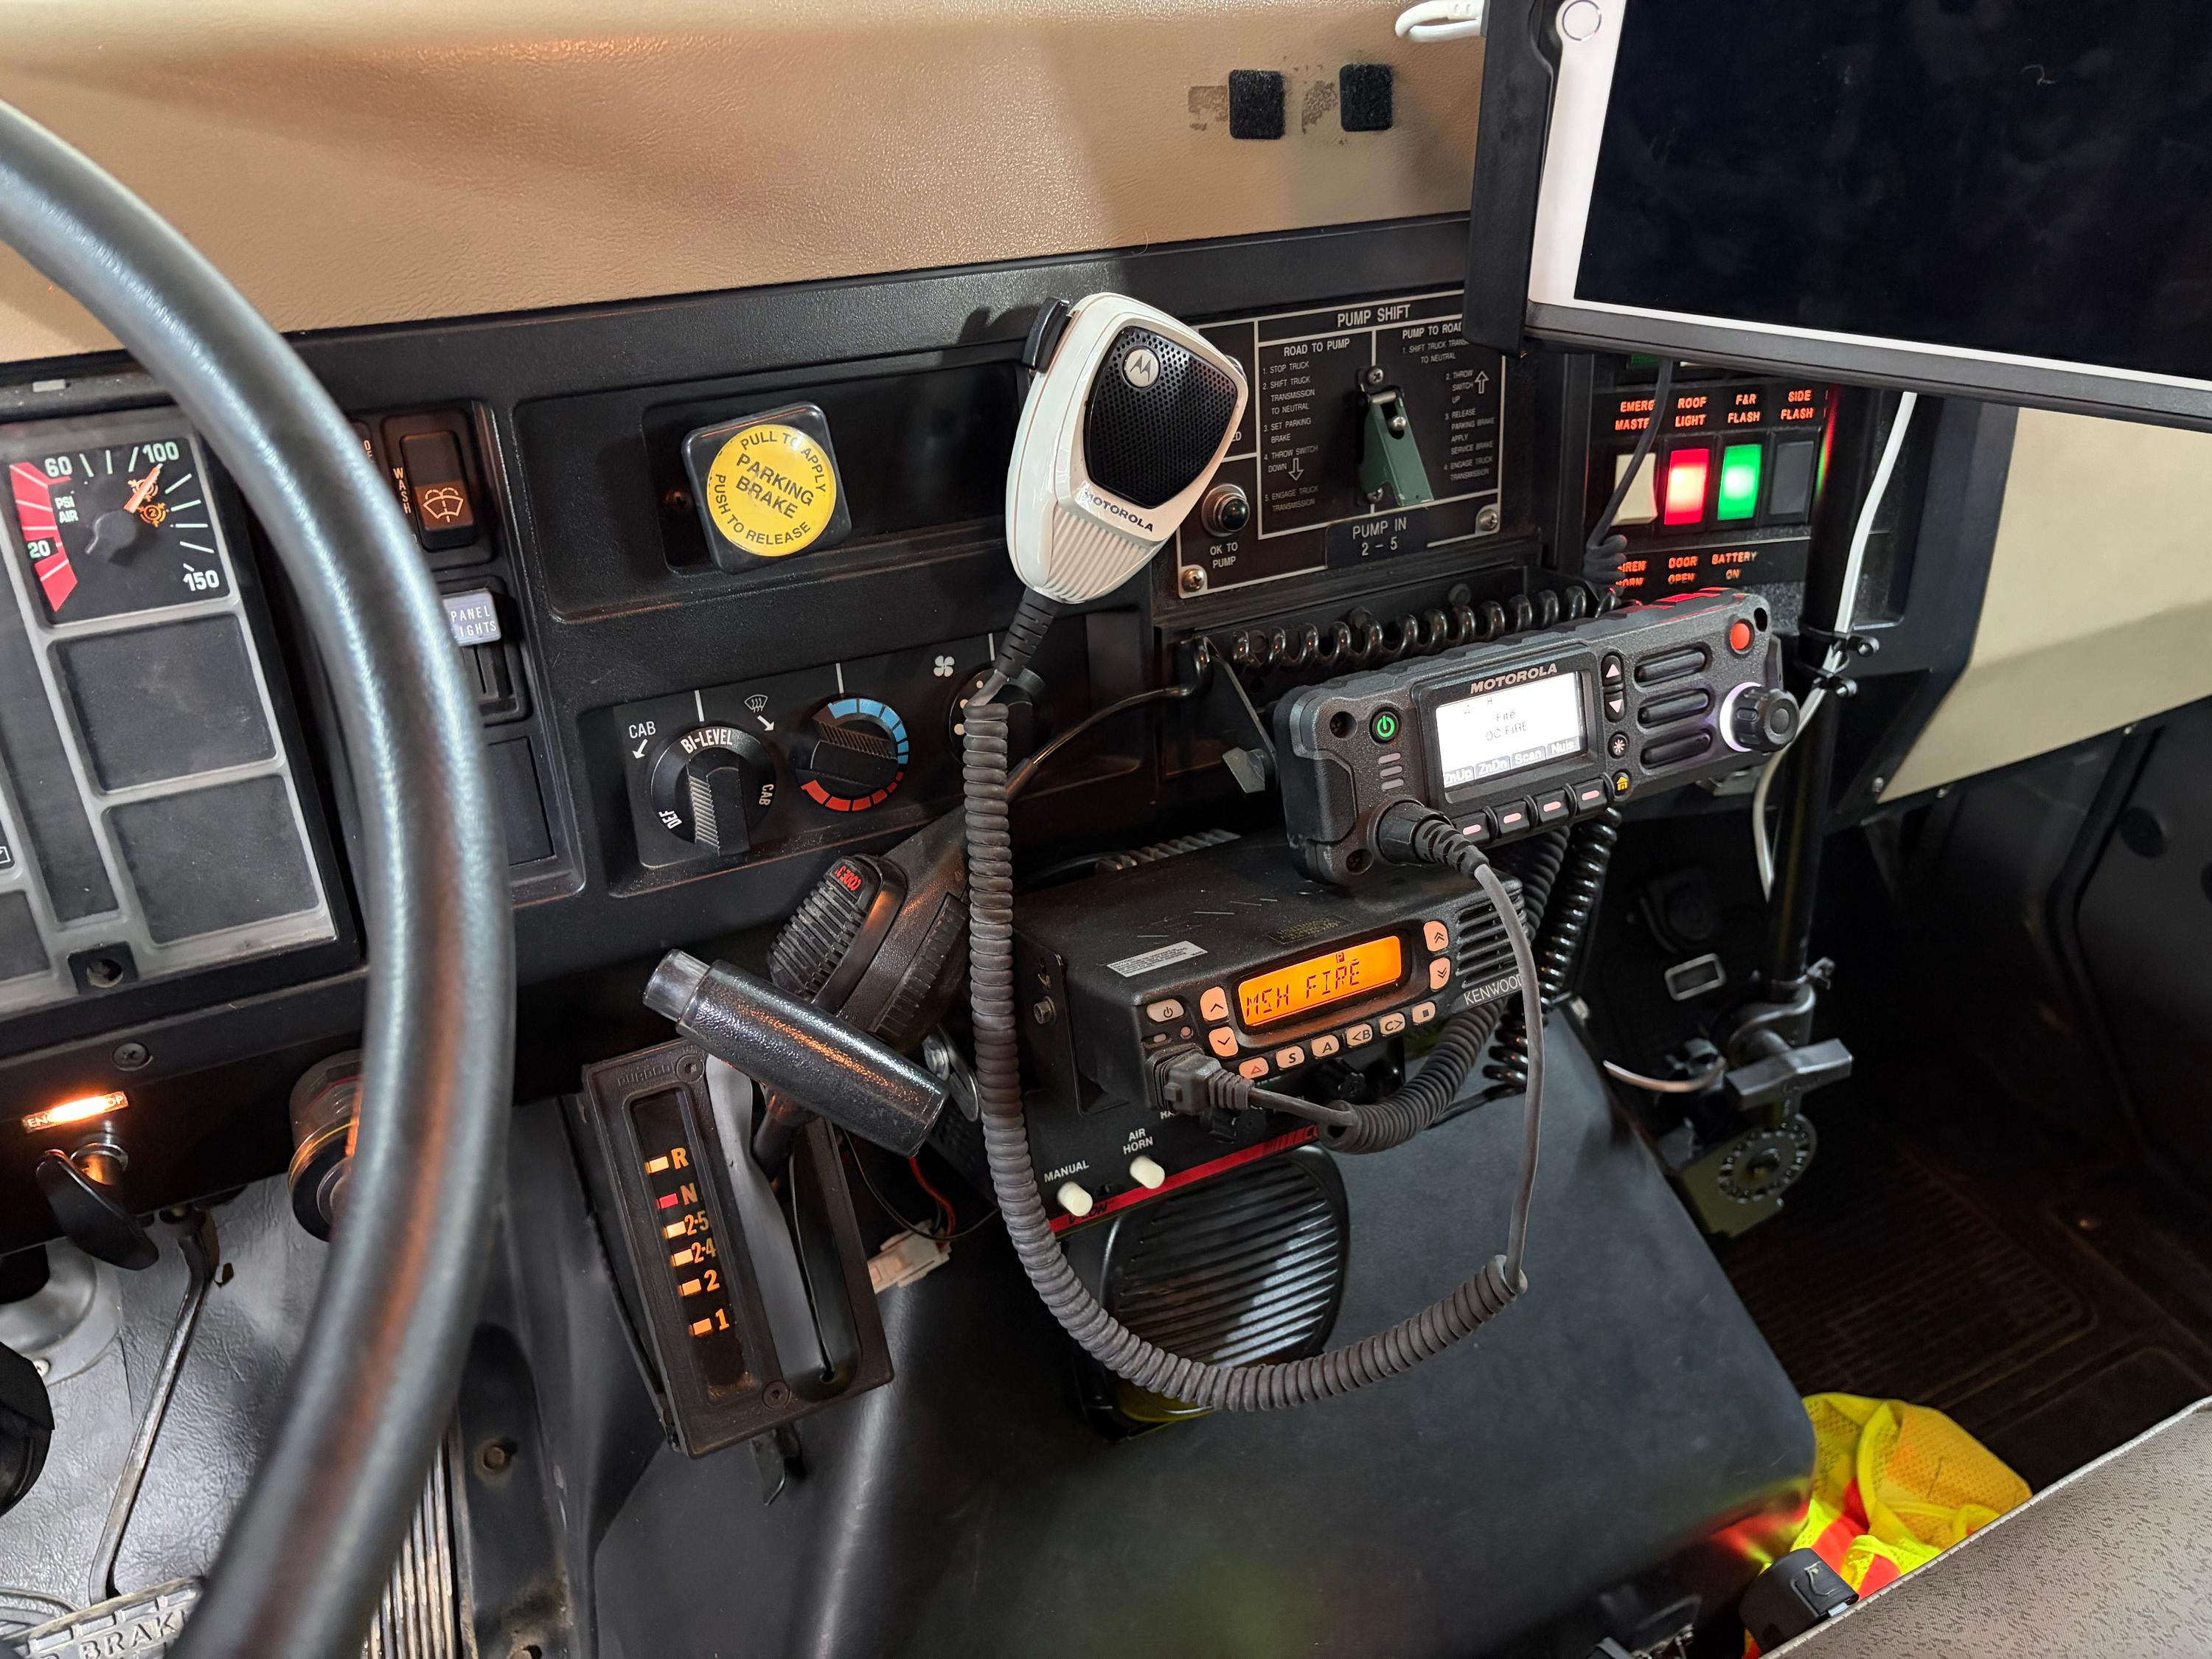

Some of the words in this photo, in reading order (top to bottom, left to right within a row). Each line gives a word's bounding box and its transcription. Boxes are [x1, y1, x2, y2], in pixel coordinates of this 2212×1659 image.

[1337, 310, 1371, 327] PUMP
[1377, 305, 1411, 323] SHIFT
[1402, 327, 1425, 340] PUMP
[1427, 325, 1439, 336] TO
[1284, 344, 1308, 357] ROAD
[1312, 342, 1324, 352] TO
[1326, 338, 1350, 351] PUMP
[1408, 343, 1425, 353] SHIFT
[1427, 341, 1447, 350] TRUCK
[1431, 352, 1456, 362] NEUTRAL
[1270, 364, 1287, 374] STOP
[1289, 361, 1310, 370] TRUCK
[1453, 369, 1474, 379] THROW
[1270, 379, 1287, 389] SHIFT
[1290, 376, 1310, 386] TRUCK
[1452, 382, 1474, 392] SWITCH
[1270, 389, 1315, 402] TRANSMISSION
[1452, 396, 1461, 404] UP
[1677, 396, 1708, 409] ROOF
[1736, 394, 1757, 406] F&R
[1788, 389, 1812, 403] SIDE
[1271, 407, 1280, 415] TO
[1282, 403, 1310, 414] NEUTRAL
[1451, 408, 1475, 419] RELEASE
[1620, 400, 1655, 413] EMERG
[1781, 407, 1814, 420] FLASH
[1270, 422, 1282, 431] SET
[1285, 417, 1312, 428] PARKING
[1615, 417, 1651, 431] MASTE
[1674, 414, 1707, 428] LIGHT
[1728, 411, 1761, 424] FLASH
[1270, 434, 1291, 444] BRAKE
[1451, 434, 1469, 443] APPLY
[142, 442, 179, 463] 100
[1271, 449, 1294, 460] THROW
[1295, 445, 1319, 455] SWITCH
[44, 456, 72, 477] 60
[740, 431, 777, 451] PULL
[782, 432, 804, 451] TO
[801, 448, 826, 493] APPLY
[1268, 462, 1287, 473] DOWN
[736, 453, 814, 507] PARKING
[393, 467, 411, 513] WASH
[1271, 489, 1296, 501] ENGAGE
[1298, 485, 1319, 494] TRUCK
[55, 495, 75, 509] PSI
[736, 476, 798, 519] BRAKE
[714, 473, 731, 515] PUSH
[727, 514, 745, 533] TO
[745, 521, 811, 546] RELEASE
[1084, 490, 1153, 532] MOTOROLA
[1272, 498, 1315, 512] TRANSMISSION
[59, 510, 79, 524] AIR
[1352, 521, 1388, 540] PUMP
[1394, 517, 1407, 532] IN
[27, 540, 51, 559] 20
[1209, 544, 1222, 556] OK
[1226, 542, 1238, 553] TO
[1361, 542, 1369, 557] 2
[1390, 537, 1398, 551] 5
[1212, 557, 1237, 569] PUMP
[1668, 556, 1699, 569] DOOR
[1711, 552, 1758, 566] BATTERY
[183, 570, 220, 591] 150
[1668, 573, 1696, 585] OPEN
[1725, 568, 1742, 580] ON
[451, 605, 490, 622] PANEL
[453, 621, 497, 639] IGHTS
[1470, 663, 1558, 695] MOTOROLA
[629, 721, 656, 739] CAB
[1486, 728, 1501, 741] OC
[1505, 722, 1528, 736] FIRE
[681, 728, 733, 754] BI-LEVEL
[1444, 769, 1474, 785] ZnUp
[1478, 759, 1508, 776] ZnDn
[1514, 749, 1542, 765] Scan
[1551, 740, 1575, 755] Nuis
[759, 783, 774, 806] CAB
[658, 810, 683, 830] DEF
[1246, 984, 1289, 1018] MSH
[1306, 960, 1360, 999] FIRE
[1322, 1042, 1332, 1054] A
[1289, 1052, 1295, 1063] S
[1128, 1128, 1146, 1141] AIR
[1122, 1136, 1154, 1155] HORN
[671, 1147, 689, 1169] R
[1044, 1160, 1090, 1183] MANUAL
[680, 1182, 698, 1206] N
[703, 1269, 720, 1292] 2
[714, 1308, 730, 1331] 1
[79, 1610, 187, 1659] BRAK
